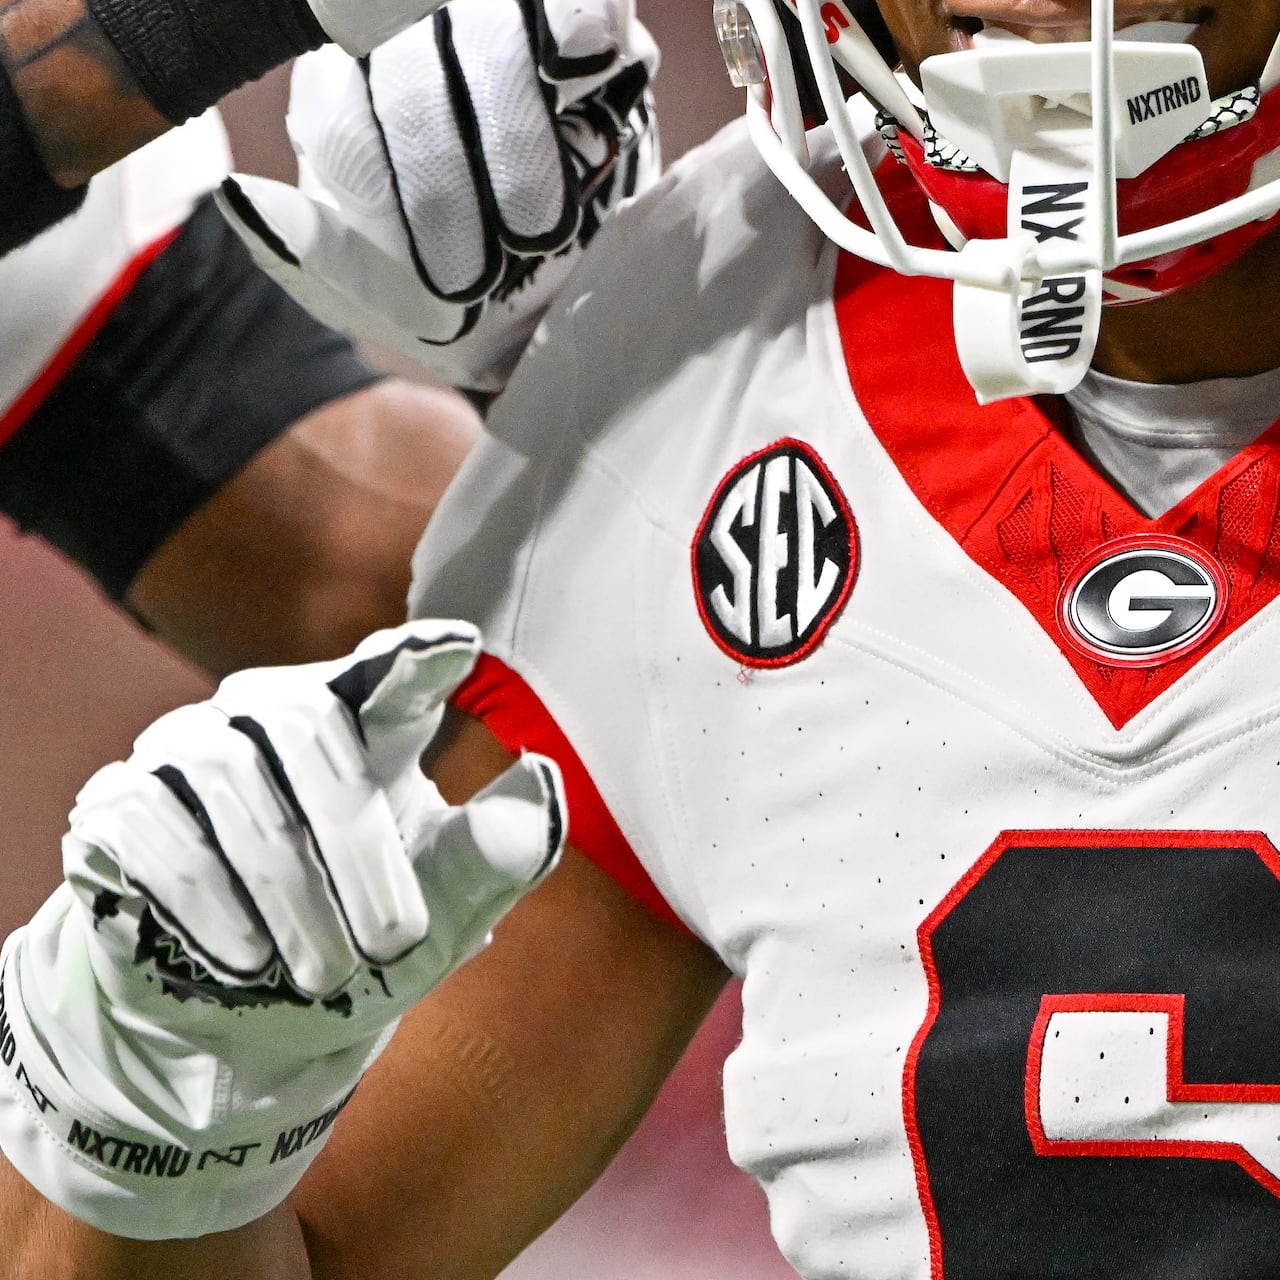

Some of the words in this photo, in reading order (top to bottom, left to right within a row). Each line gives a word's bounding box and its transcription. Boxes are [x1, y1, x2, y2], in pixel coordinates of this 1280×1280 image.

[1126, 76, 1201, 126] NXTRND
[1019, 181, 1090, 364] NXRND
[709, 455, 840, 648] SEC
[1075, 555, 1212, 649] G
[67, 1119, 193, 1178] NXTRND
